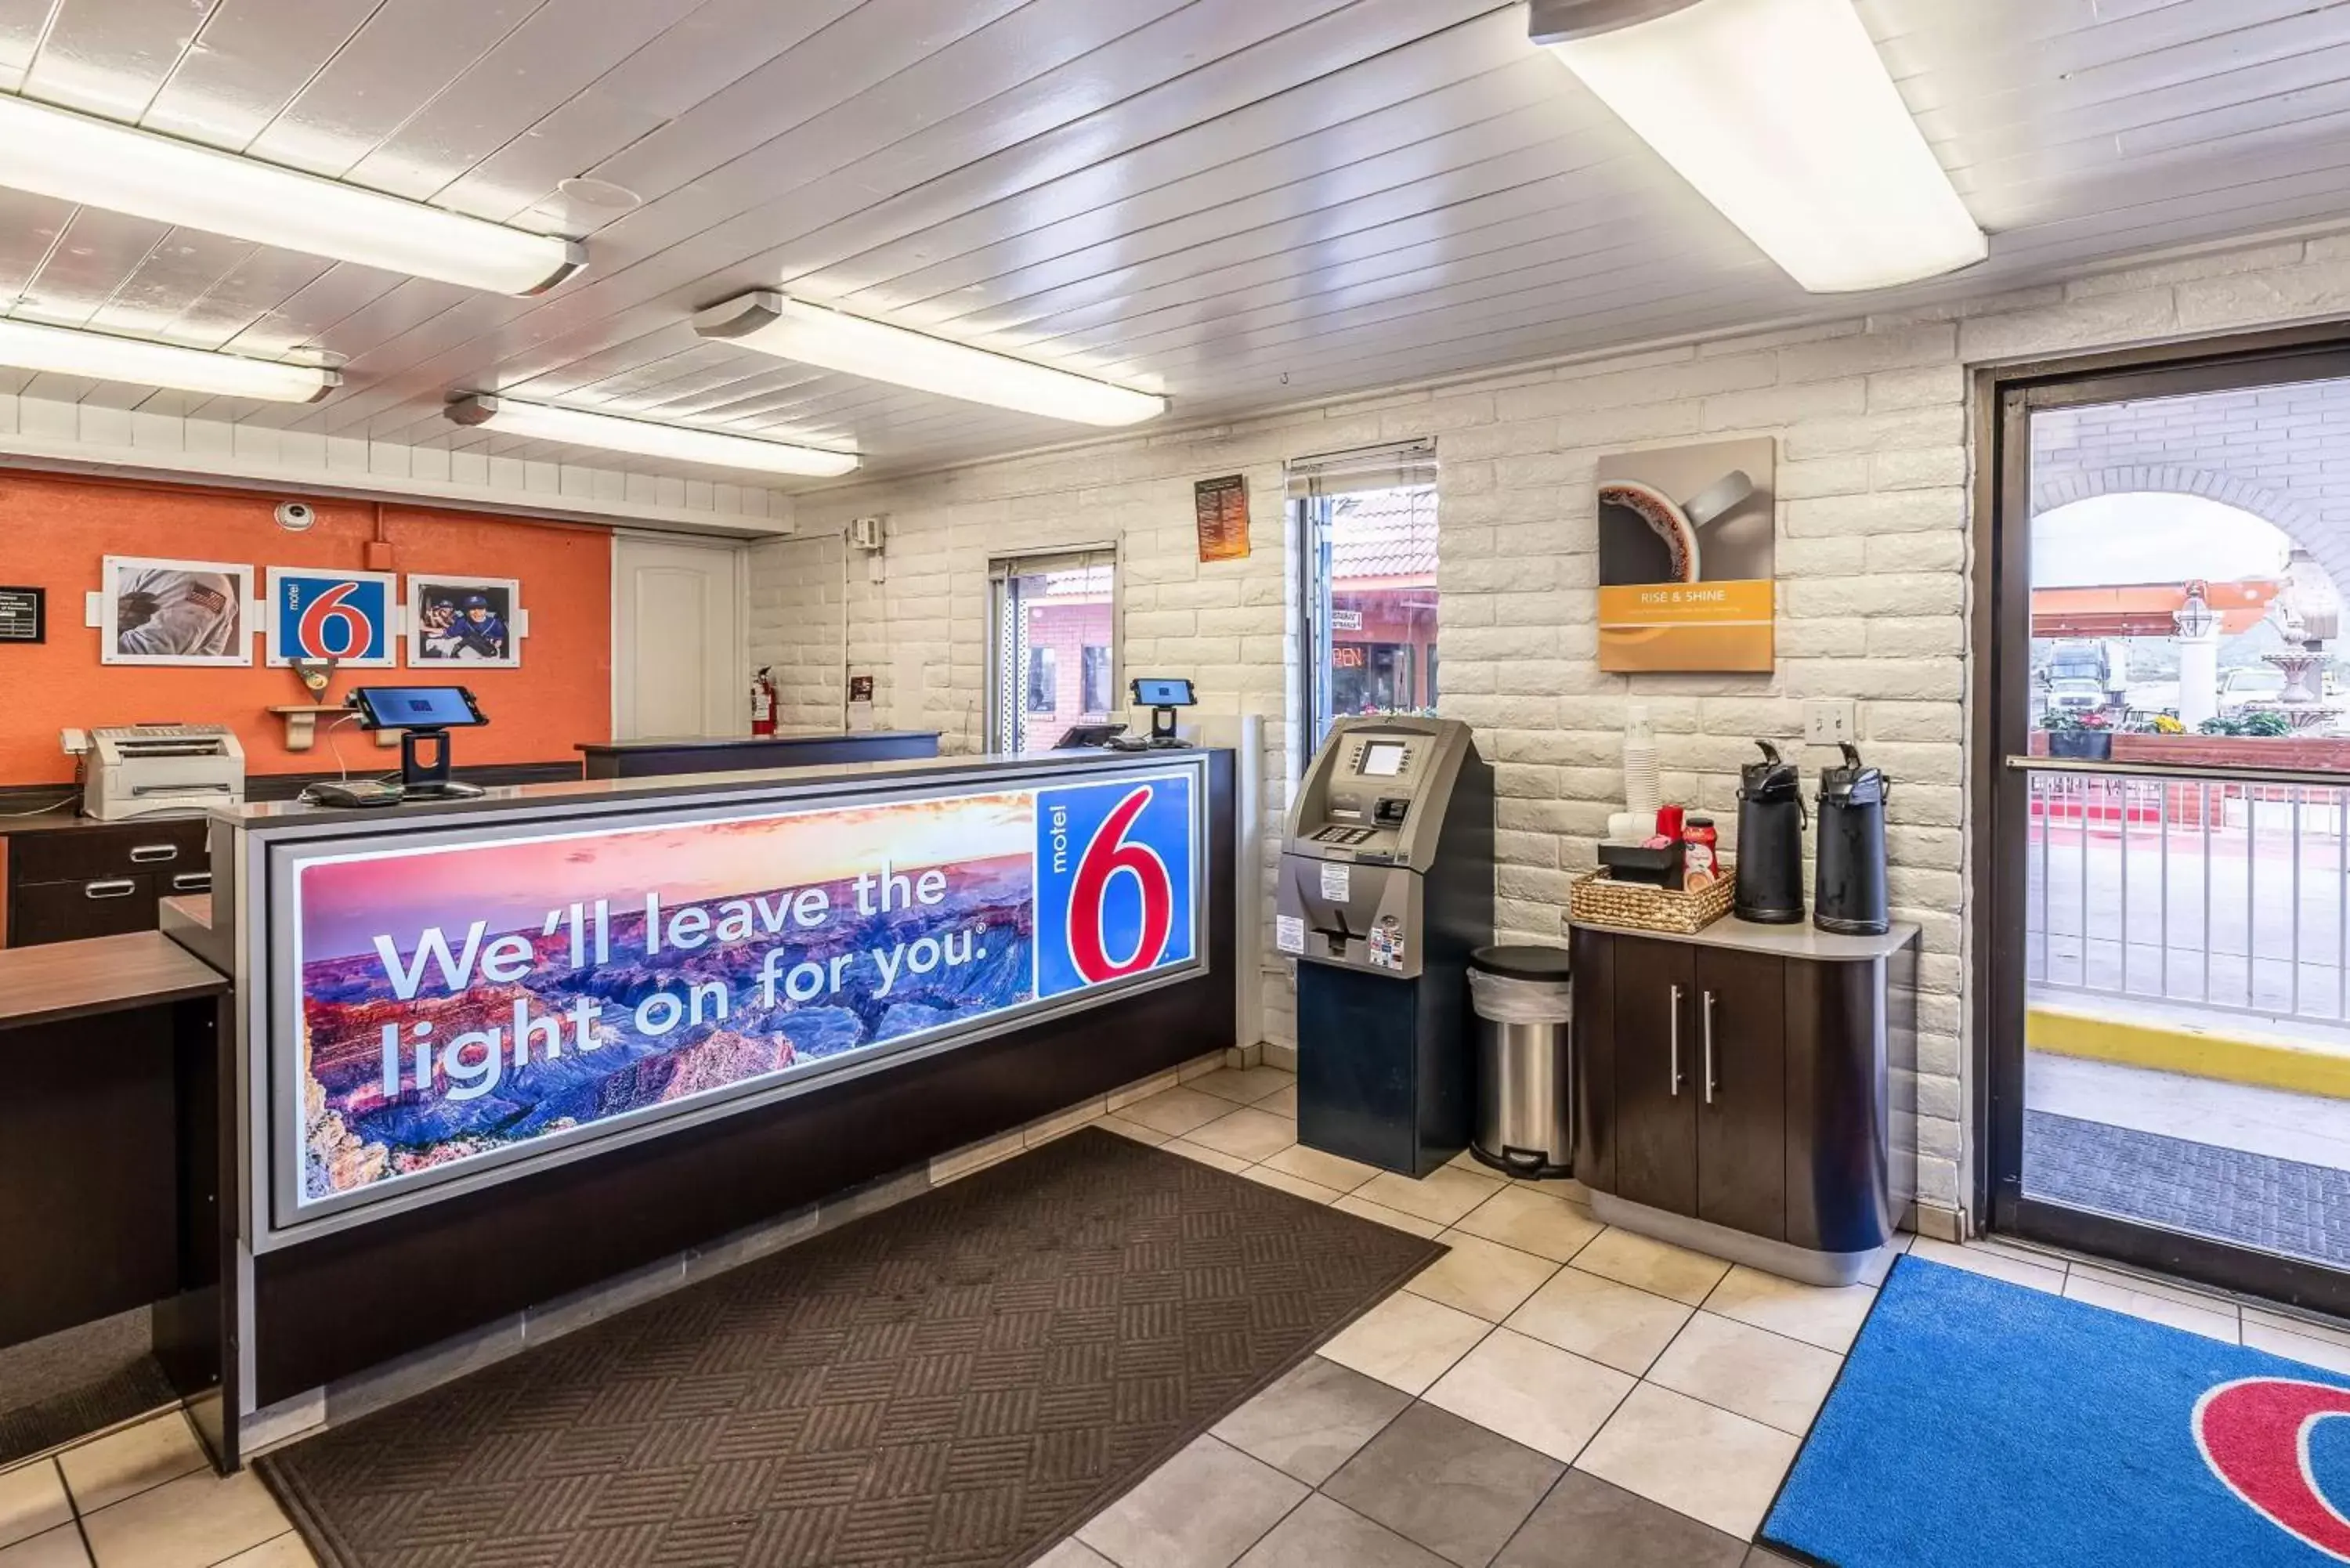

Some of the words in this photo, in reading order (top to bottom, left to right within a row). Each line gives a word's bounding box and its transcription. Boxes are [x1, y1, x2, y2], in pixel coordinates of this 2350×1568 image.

[288, 583, 299, 611] motel
[298, 582, 372, 659] 6
[1641, 592, 1668, 603] RISE
[1672, 592, 1681, 602] &
[1686, 590, 1726, 602] SHINE
[1332, 648, 1361, 667] PEN
[373, 899, 609, 1001] We'll
[646, 891, 830, 956] leave
[853, 859, 947, 916] the
[1049, 804, 1067, 874] motel
[1066, 784, 1173, 986] 6
[381, 995, 602, 1100] light
[634, 981, 728, 1036] on
[756, 948, 853, 1009] for
